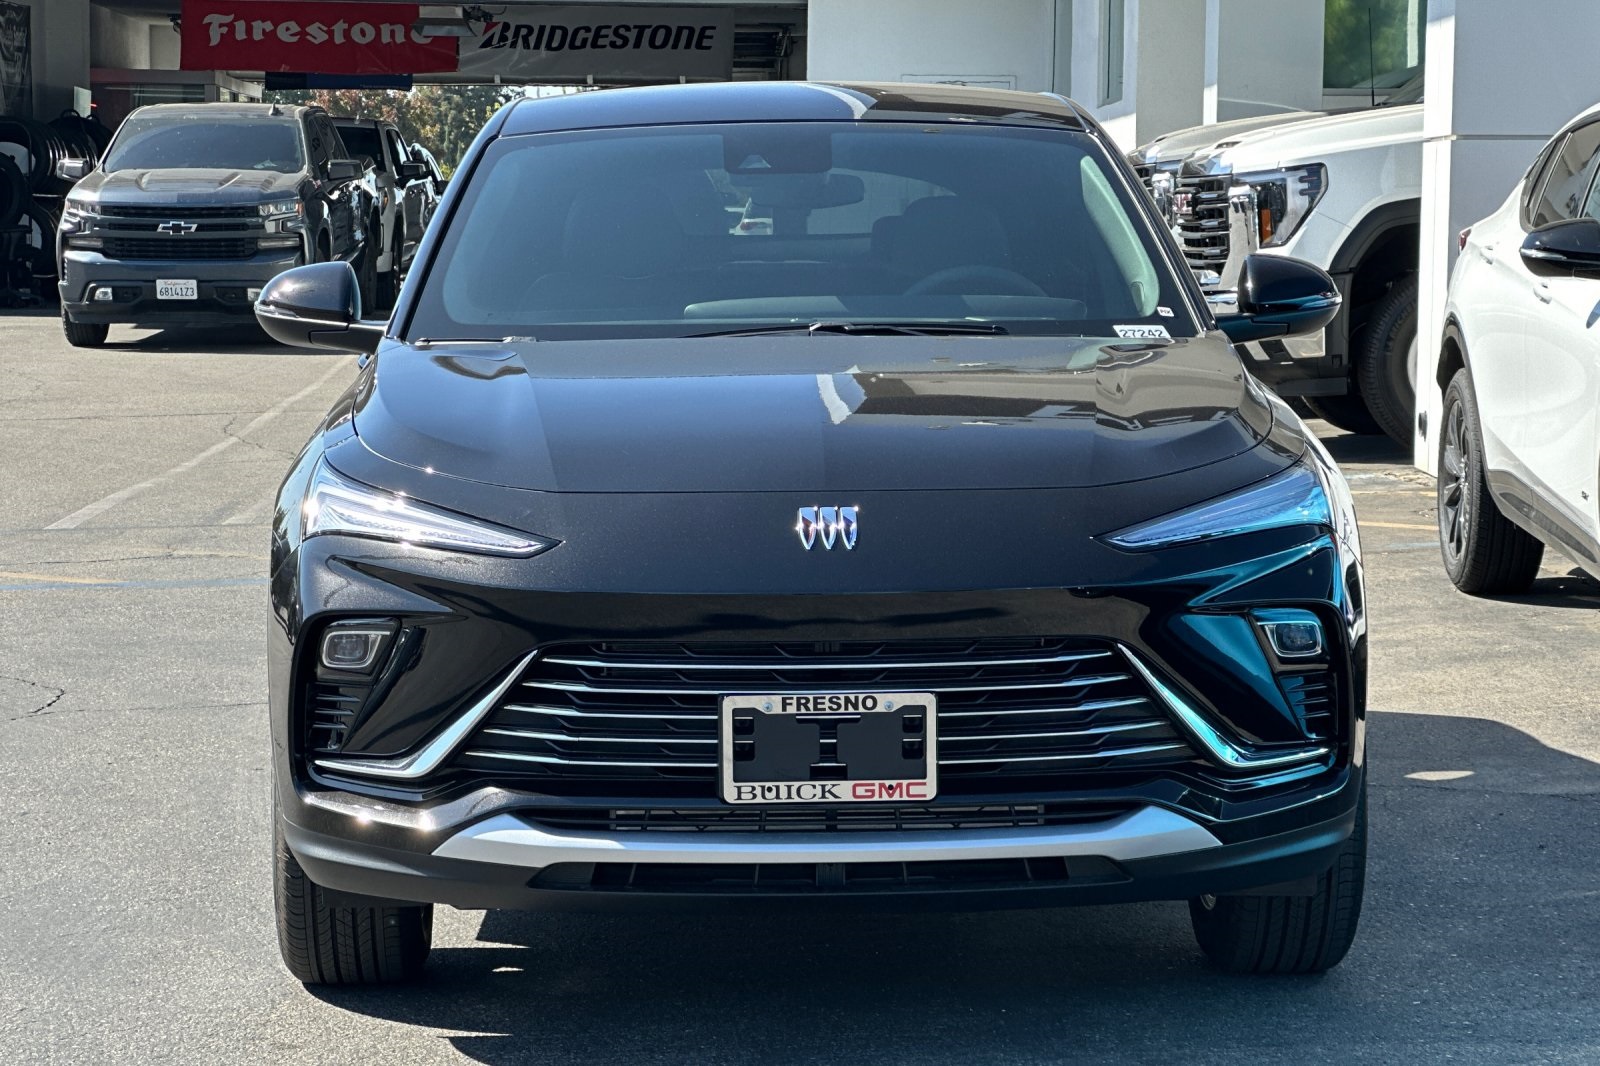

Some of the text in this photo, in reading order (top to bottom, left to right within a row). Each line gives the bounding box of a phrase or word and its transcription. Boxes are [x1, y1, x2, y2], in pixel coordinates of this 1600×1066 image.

[479, 21, 717, 51] BRIDGESTONE
[159, 286, 195, 296] 68141Z3
[1119, 329, 1166, 338] 27242
[781, 695, 878, 712] FRESNO
[733, 782, 927, 800] BUICK GMC
